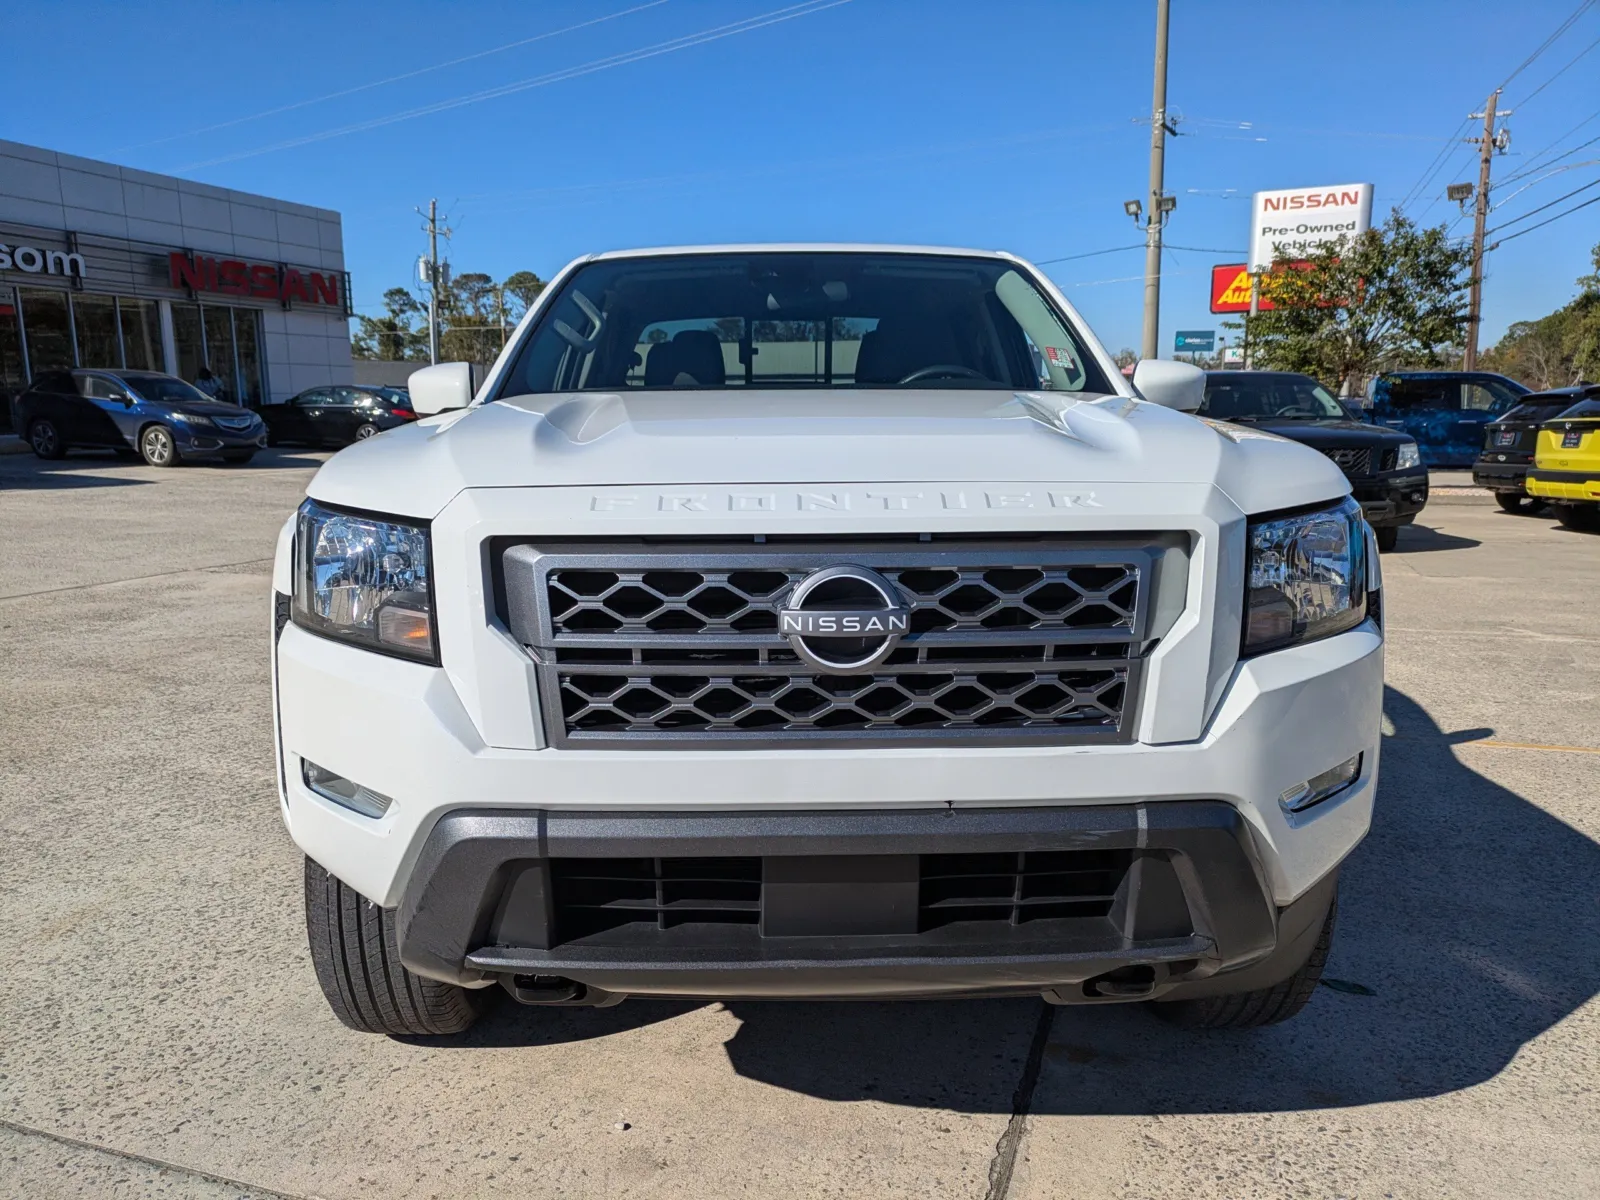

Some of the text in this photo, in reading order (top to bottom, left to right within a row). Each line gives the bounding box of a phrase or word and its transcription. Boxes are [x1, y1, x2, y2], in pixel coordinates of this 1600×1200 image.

[1263, 191, 1359, 211] NISSAN
[1262, 221, 1356, 236] Pre-Owned
[169, 252, 339, 306] NISSAN
[589, 491, 1105, 512] FRONTIER
[783, 614, 907, 632] NISSAN
